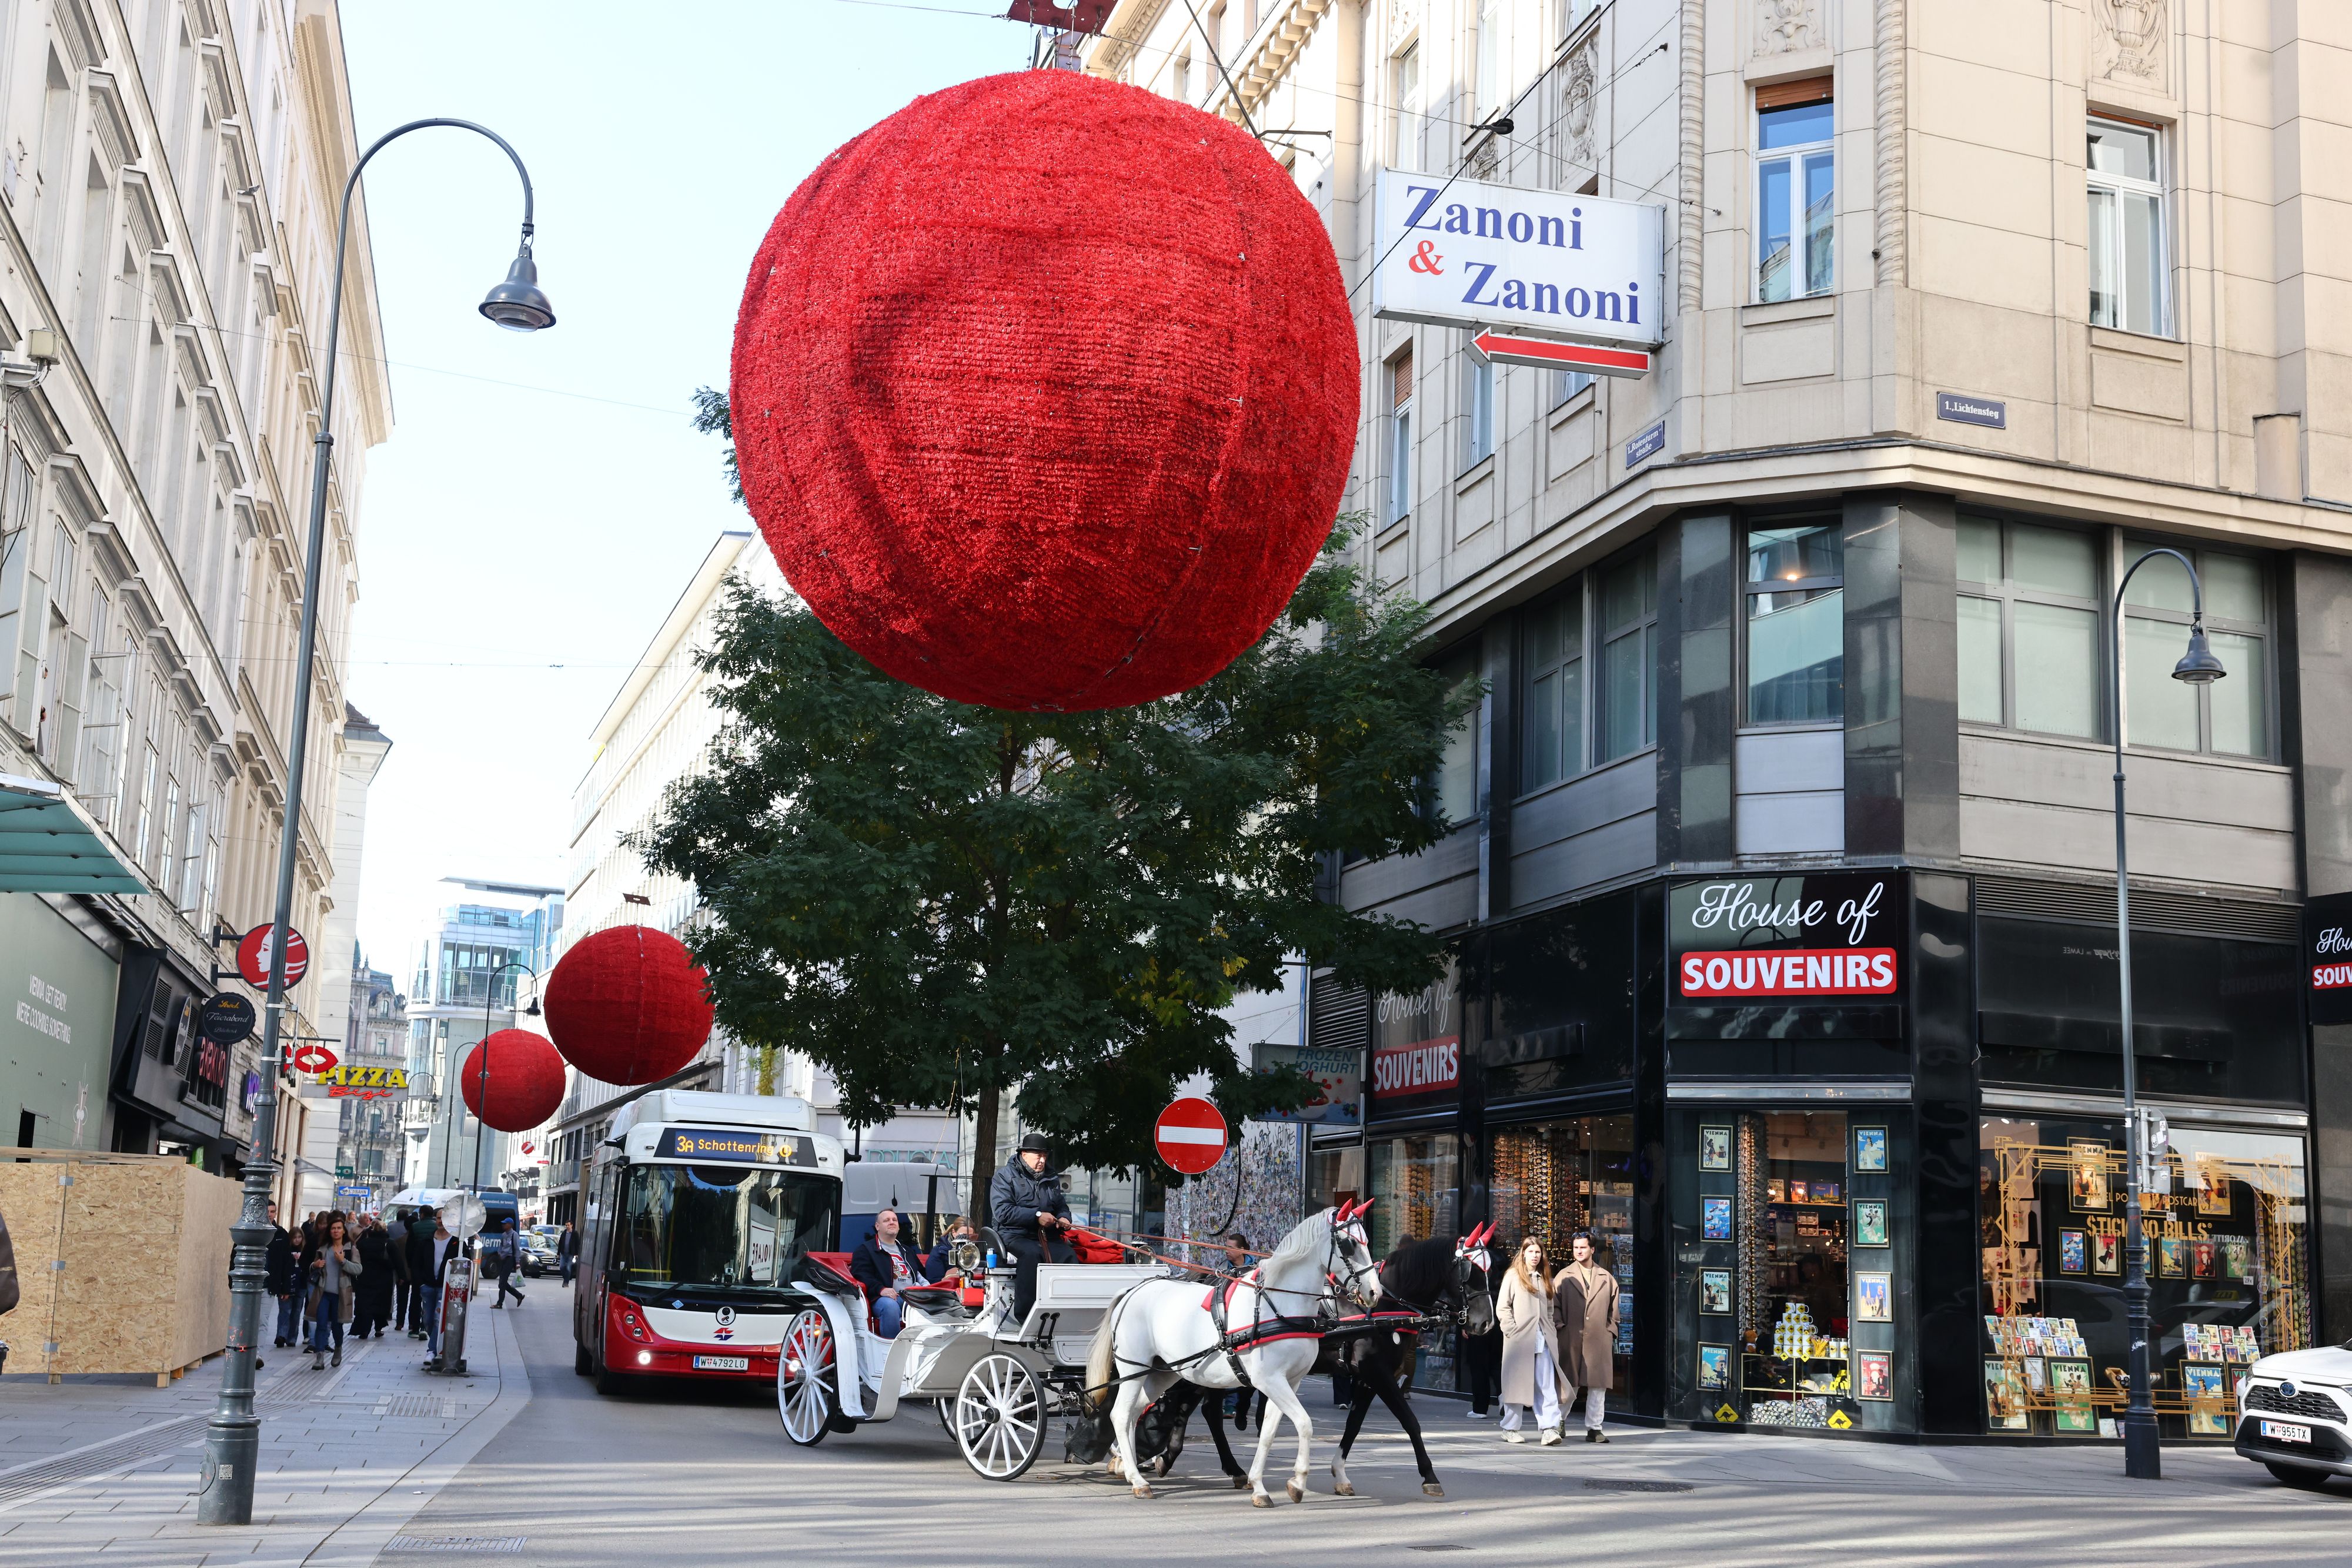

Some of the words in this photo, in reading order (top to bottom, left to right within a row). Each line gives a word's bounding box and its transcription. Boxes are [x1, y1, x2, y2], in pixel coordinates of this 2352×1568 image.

[1403, 185, 1584, 250] Zanoni
[1408, 240, 1444, 276] &
[1461, 260, 1641, 325] Zanoni
[1636, 443, 1652, 458] straße
[1691, 883, 1826, 931] House
[1836, 882, 1884, 945] of
[1683, 954, 1893, 991] SOUVENIRS
[45, 984, 55, 1007] GET
[1378, 985, 1432, 1024] House
[1435, 960, 1456, 1034] of
[30, 1007, 49, 1034] COOKING
[206, 1012, 250, 1022] Feierabend
[1297, 1049, 1352, 1062] FROZEN
[1374, 1042, 1458, 1092] SOUVENIRS
[316, 1066, 408, 1088] PIZZA
[677, 1136, 694, 1153] 3A
[698, 1139, 774, 1156] Schottenring
[2053, 1364, 2087, 1373] VIENNA
[2187, 1369, 2220, 1378] VIENNA
